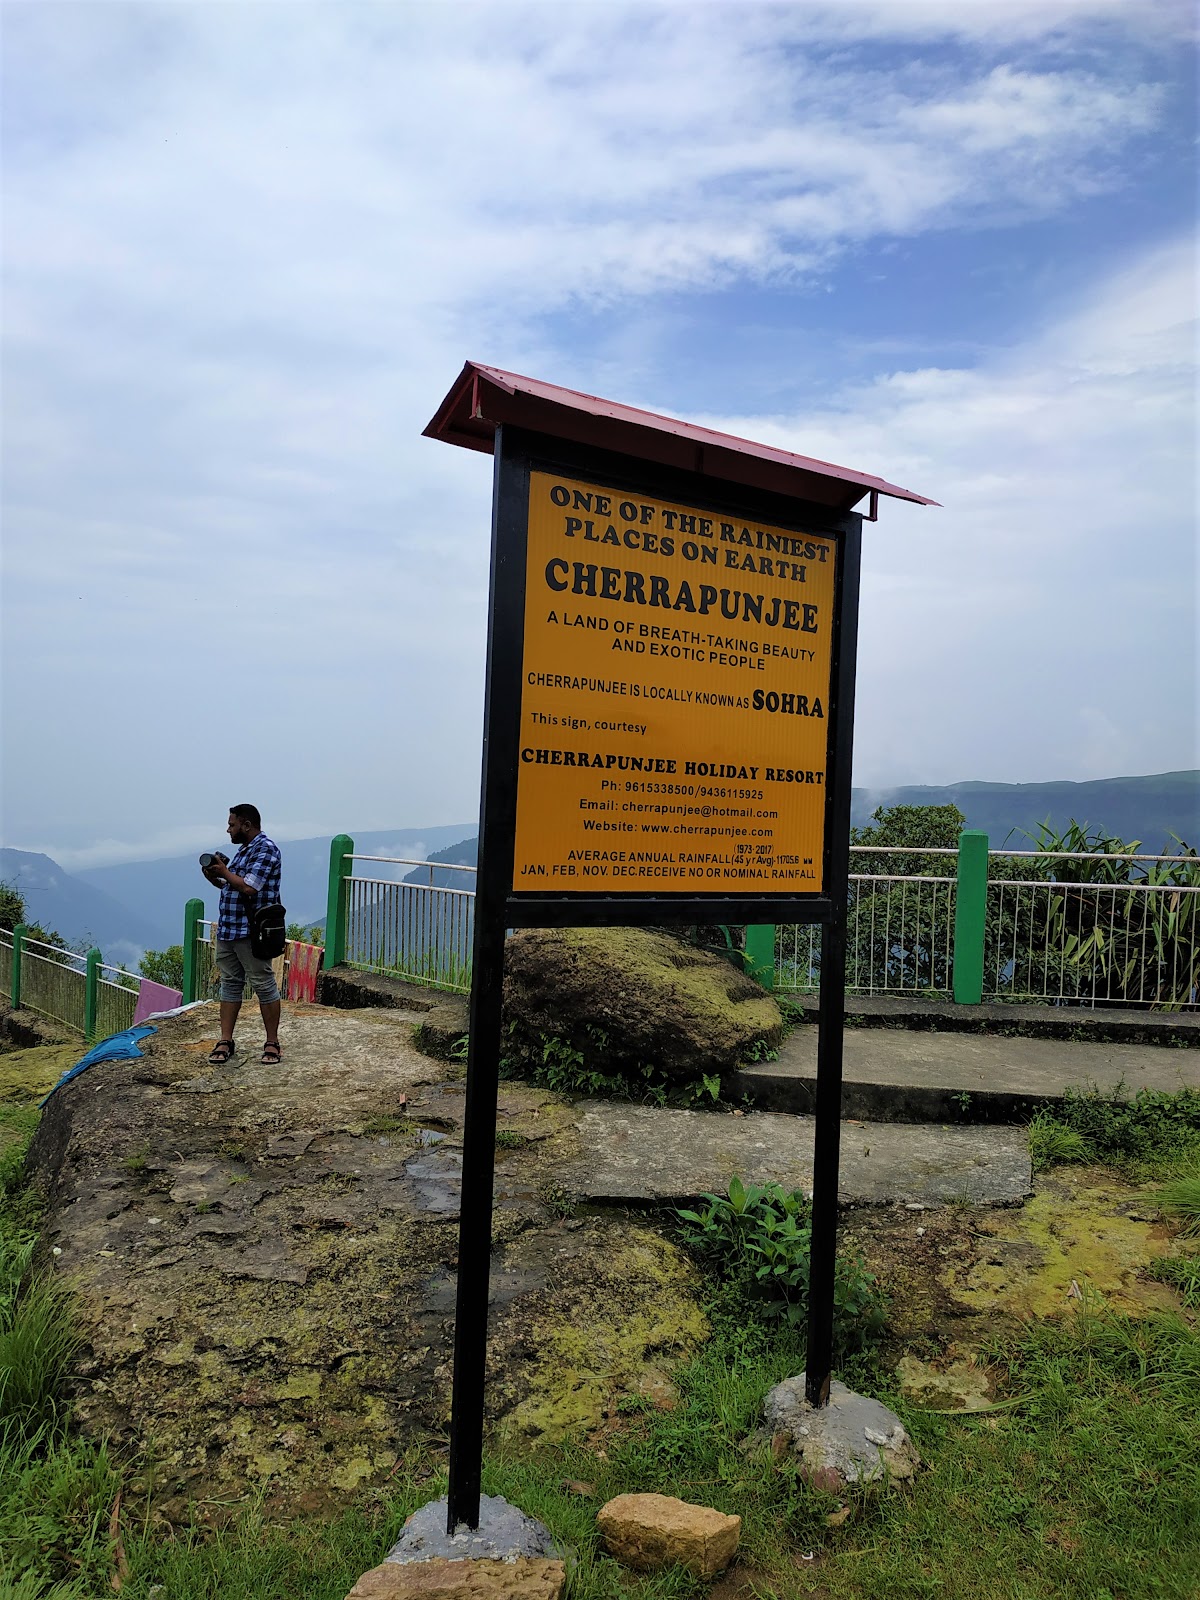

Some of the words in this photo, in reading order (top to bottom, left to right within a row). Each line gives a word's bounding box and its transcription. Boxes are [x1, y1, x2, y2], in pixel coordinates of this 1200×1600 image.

[550, 485, 612, 518] ONE
[619, 501, 655, 525] OF
[661, 509, 713, 538] THE
[720, 522, 830, 563] RAINIEST
[564, 516, 676, 556] PLACES
[681, 541, 719, 565] ON
[724, 549, 807, 583] EARTH
[545, 556, 819, 634] CHERRAPUNJEE
[547, 610, 558, 624] A
[564, 612, 609, 631] LAND
[613, 620, 635, 634] OF
[639, 624, 759, 654] BREATH-TAKING
[763, 643, 815, 662] BEAUTY
[611, 638, 645, 653] AND
[650, 642, 705, 662] EXOTIC
[709, 651, 765, 670] PEOPLE
[528, 672, 627, 695] CHERRAPUNJEE
[630, 684, 640, 697] IS
[643, 685, 693, 702] LOCALLY
[695, 692, 734, 707] KNOWN
[736, 696, 749, 709] AS
[752, 689, 824, 718] SOHRA
[531, 712, 558, 725] This
[561, 716, 591, 730] sign,
[594, 721, 647, 736] courtesy
[521, 748, 677, 774] CHERRAPUNJEE
[684, 761, 759, 780] HOLIDAY
[765, 768, 824, 784] RESORT
[601, 780, 621, 791] Ph:
[625, 781, 763, 800] 9615338500/9436115925
[580, 798, 618, 811] Email:
[622, 801, 778, 818] cherrapunjee@hotmail.com
[583, 820, 637, 832] Website:
[641, 824, 773, 838] www.cherrapunjee.com
[521, 864, 549, 877] JAN,
[552, 865, 579, 877] FEB,
[689, 867, 704, 877] NO
[706, 868, 721, 878] OR
[723, 868, 769, 879] NOMINAL
[772, 869, 816, 879] RAINFALL
[567, 850, 626, 862] AVERAGE
[628, 852, 676, 863] ANNUAL
